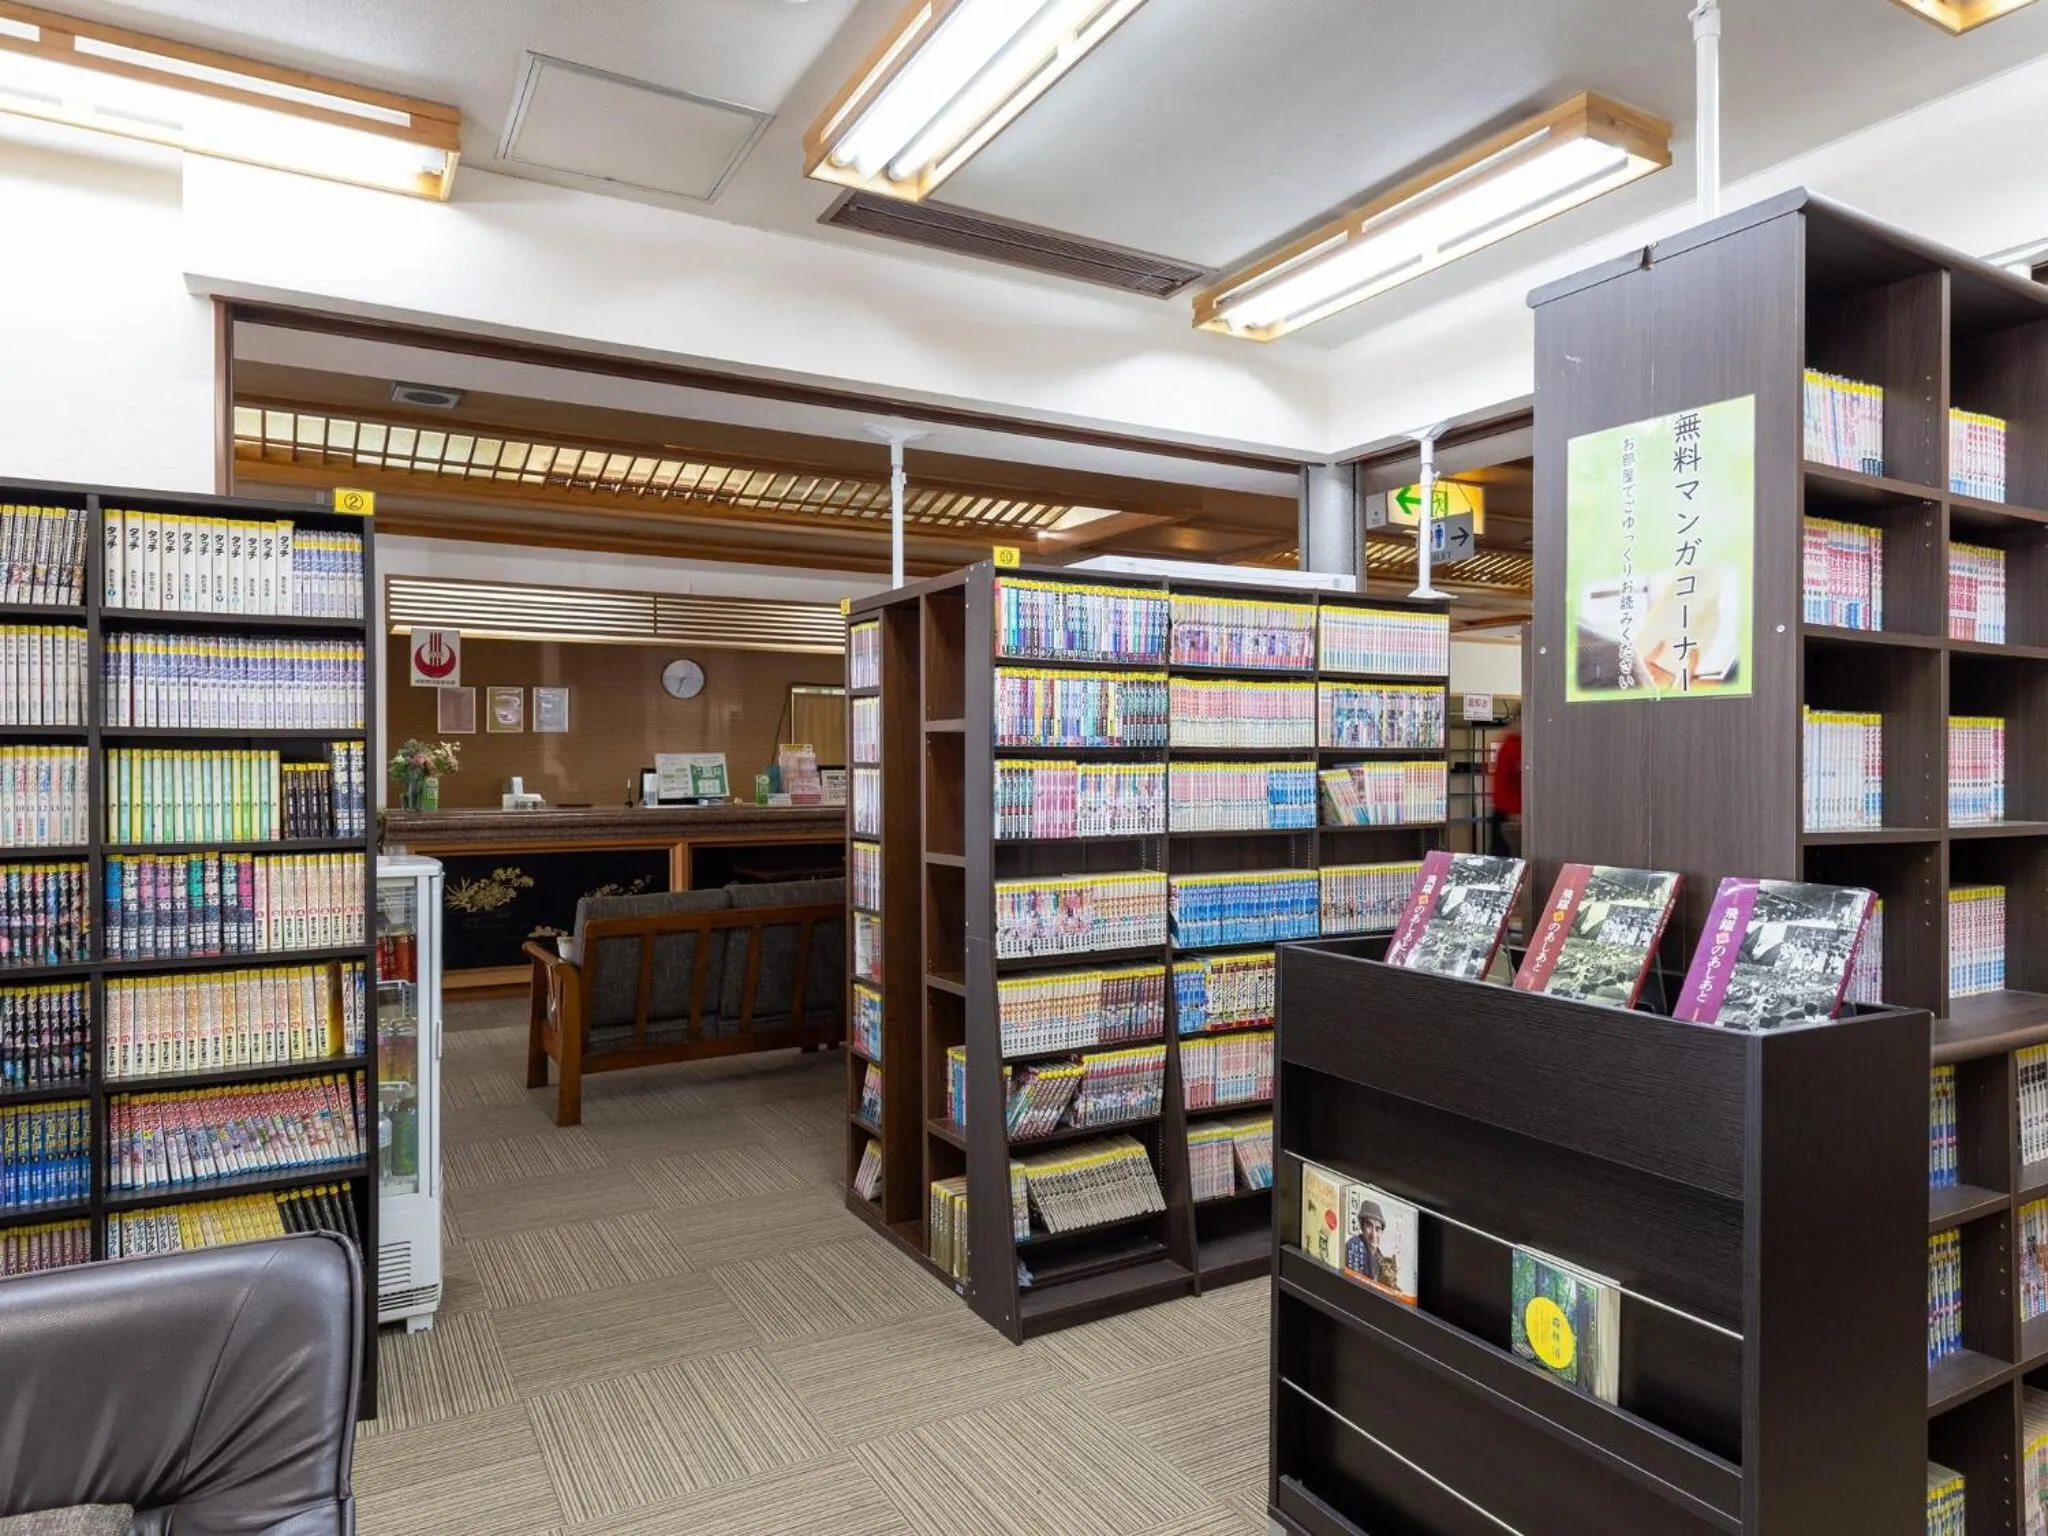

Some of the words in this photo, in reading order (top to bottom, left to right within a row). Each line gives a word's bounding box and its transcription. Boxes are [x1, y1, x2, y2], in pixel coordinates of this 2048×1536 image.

[107, 526, 117, 549] タッチ
[129, 528, 139, 550] タッチ
[148, 529, 158, 552] タッチ
[165, 531, 175, 554] タッチ
[182, 532, 192, 555] タッチ
[199, 533, 209, 555] タッチ
[215, 534, 225, 556] タッチ
[231, 536, 241, 559] タッチ
[248, 537, 257, 560] タッチ
[263, 538, 272, 560] タッチ
[279, 535, 289, 557] タッチ
[1673, 411, 1702, 692] 無料マンガコーナー
[1619, 437, 1636, 690] お部屋でごゆっくりお読みください
